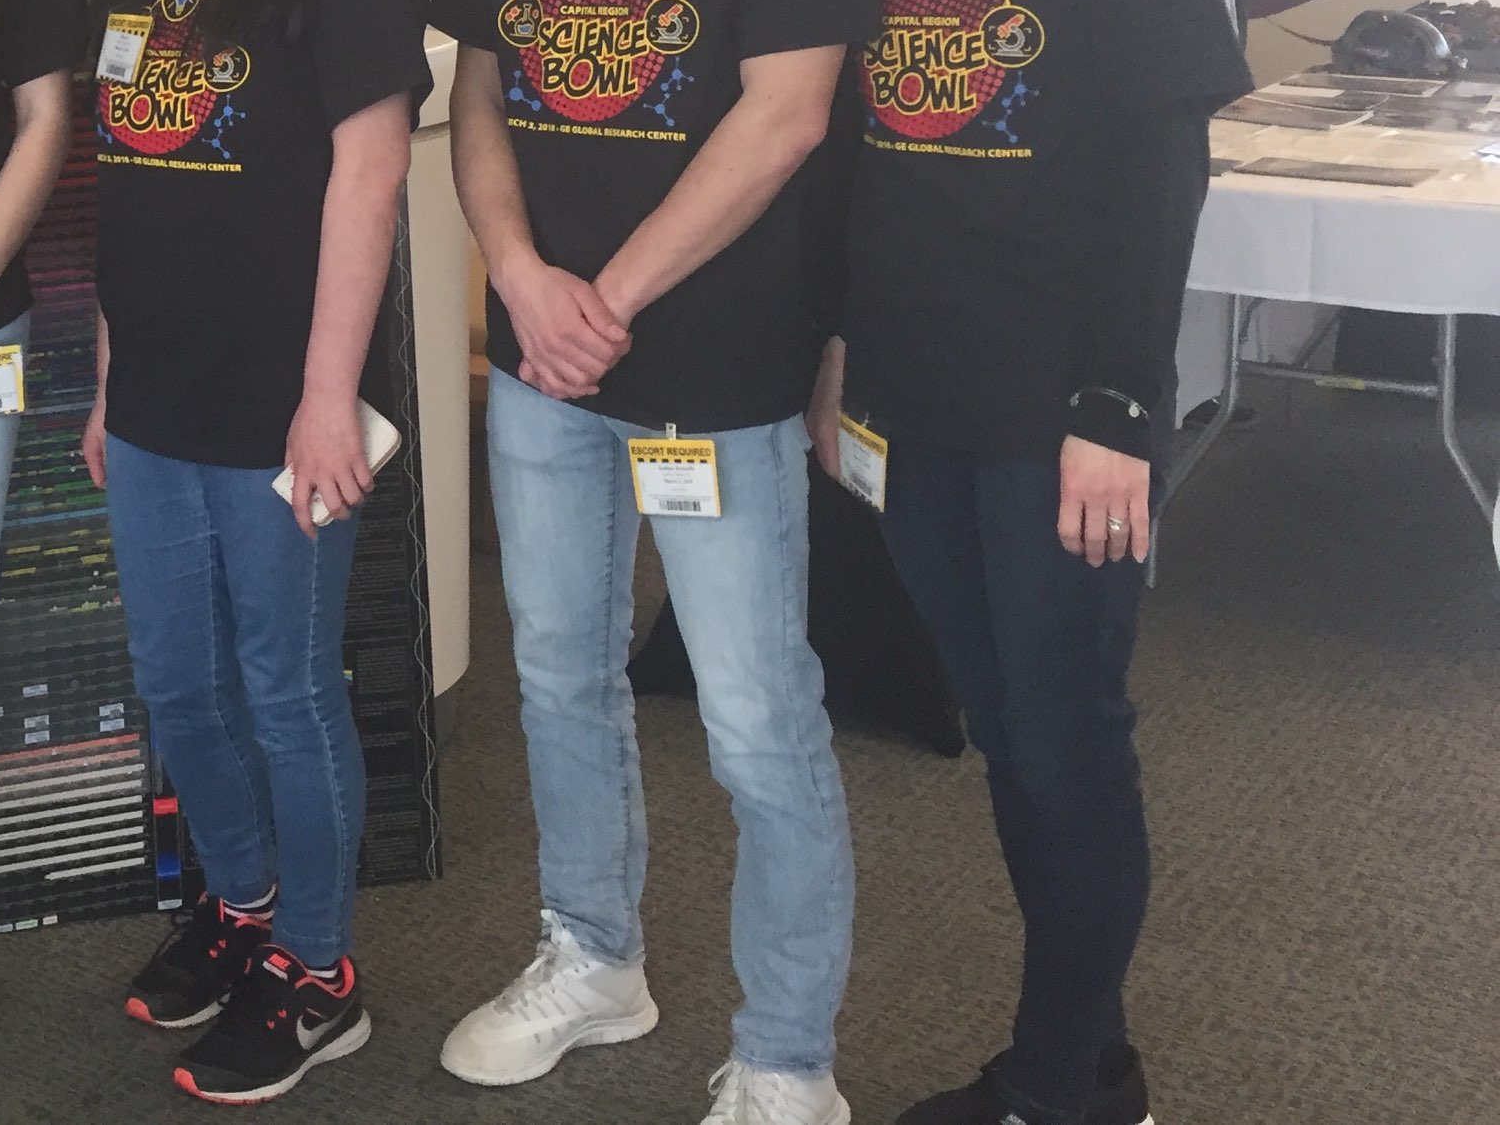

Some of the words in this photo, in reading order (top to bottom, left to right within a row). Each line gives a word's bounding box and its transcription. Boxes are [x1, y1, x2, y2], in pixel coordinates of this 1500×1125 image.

[560, 5, 598, 16] CAPITAL
[922, 16, 960, 27] REGION
[537, 18, 649, 59] SCIENCE
[541, 52, 639, 100] BOWL
[870, 64, 977, 115] BOWL
[109, 90, 196, 133] BOWL
[571, 125, 602, 136] GLOBAL
[603, 127, 646, 139] RESEARCH
[646, 130, 687, 142] CENTER
[894, 141, 907, 151] GE
[907, 142, 944, 154] GLOBAL
[987, 148, 1032, 158] CENTER
[168, 159, 207, 171] RESEARCH
[207, 162, 242, 172] CENTER
[631, 446, 664, 456] ESCORT
[666, 447, 712, 457] REQUIRED
